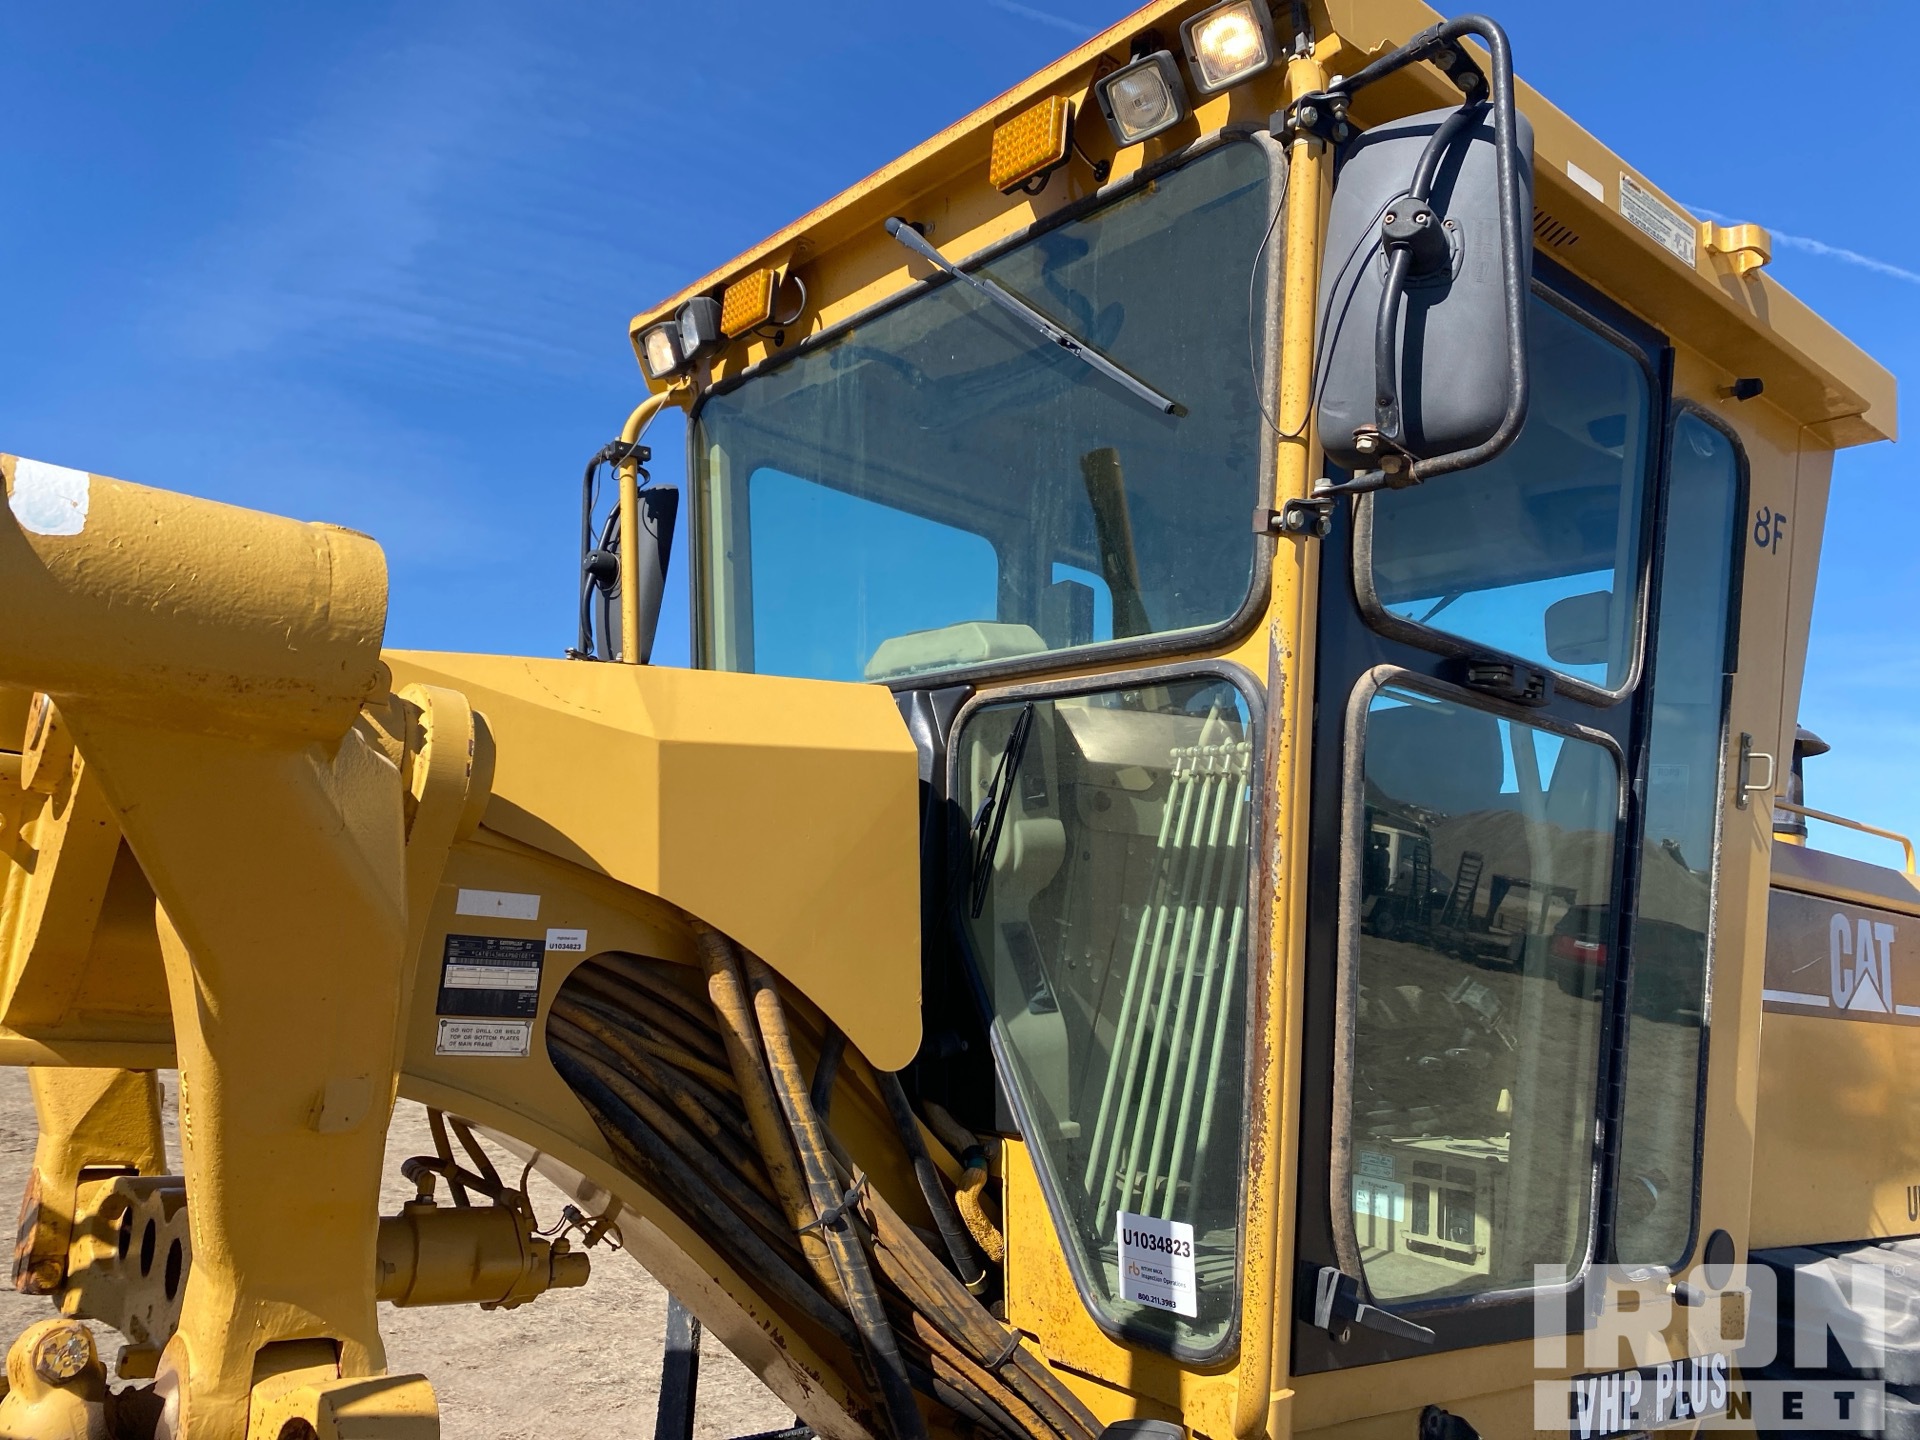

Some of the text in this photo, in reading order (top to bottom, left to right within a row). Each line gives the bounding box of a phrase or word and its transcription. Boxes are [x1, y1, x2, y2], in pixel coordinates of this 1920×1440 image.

[1754, 506, 1787, 555] 8F
[1830, 913, 1895, 1013] CAT
[1907, 1185, 1920, 1222] U
[1123, 1228, 1191, 1258] U1034823
[1128, 1261, 1140, 1276] rb
[1141, 1273, 1187, 1288] Inspection Operations
[1137, 1292, 1177, 1308] 800.211.3983
[1576, 1352, 1727, 1440] VHP PLUS
